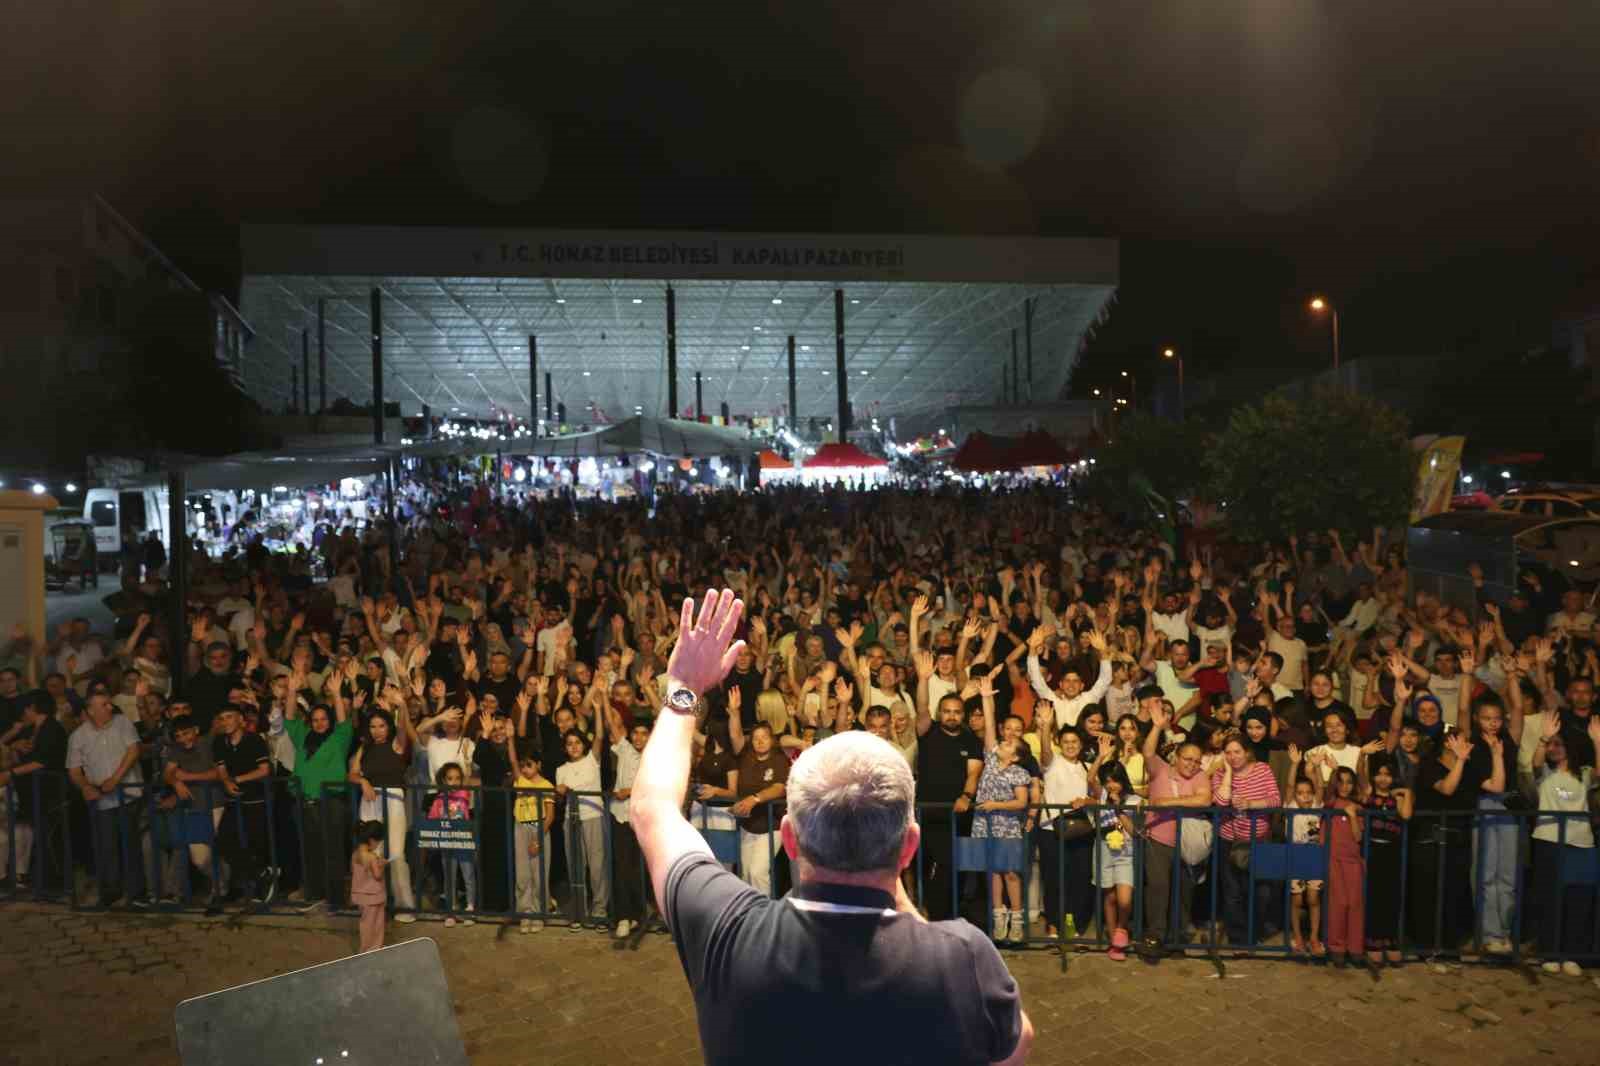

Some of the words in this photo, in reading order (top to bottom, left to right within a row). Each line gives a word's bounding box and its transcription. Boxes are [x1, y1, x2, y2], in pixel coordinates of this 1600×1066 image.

[498, 243, 537, 263] T.C.
[539, 243, 604, 263] HONAZ
[608, 240, 720, 265] BELEDİYESİ
[731, 247, 799, 265] KAPALI
